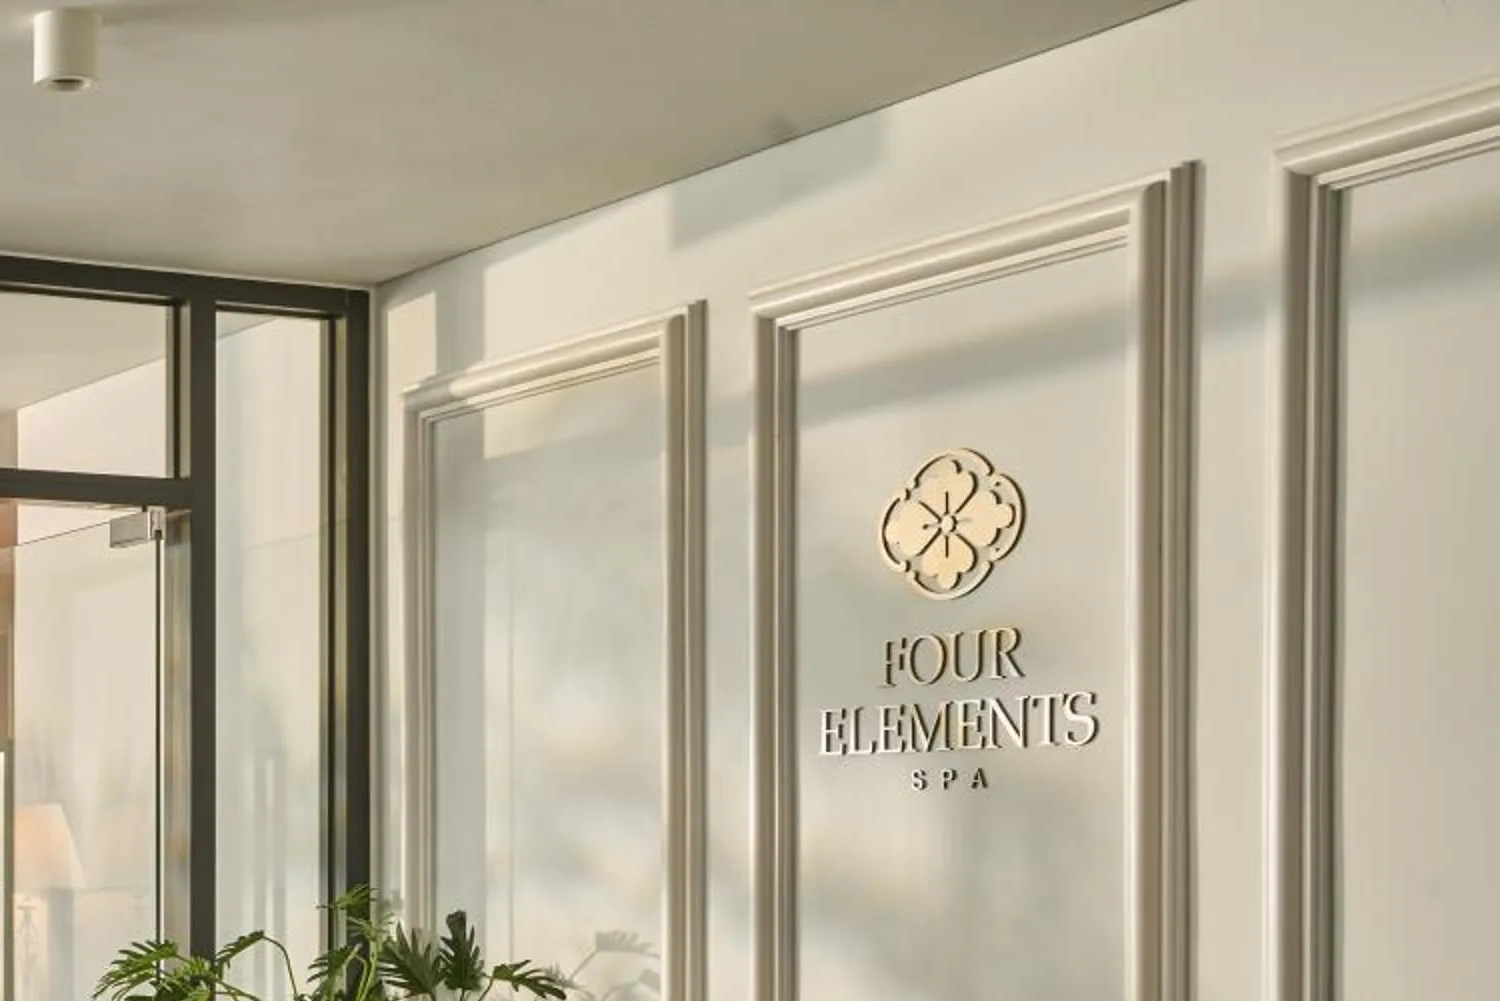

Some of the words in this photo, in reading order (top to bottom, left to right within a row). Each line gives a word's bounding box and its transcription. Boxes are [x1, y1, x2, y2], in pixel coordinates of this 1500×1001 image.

[880, 627, 1026, 688] FOUR
[819, 690, 1100, 756] ELEMENTS
[911, 767, 990, 791] SPA
